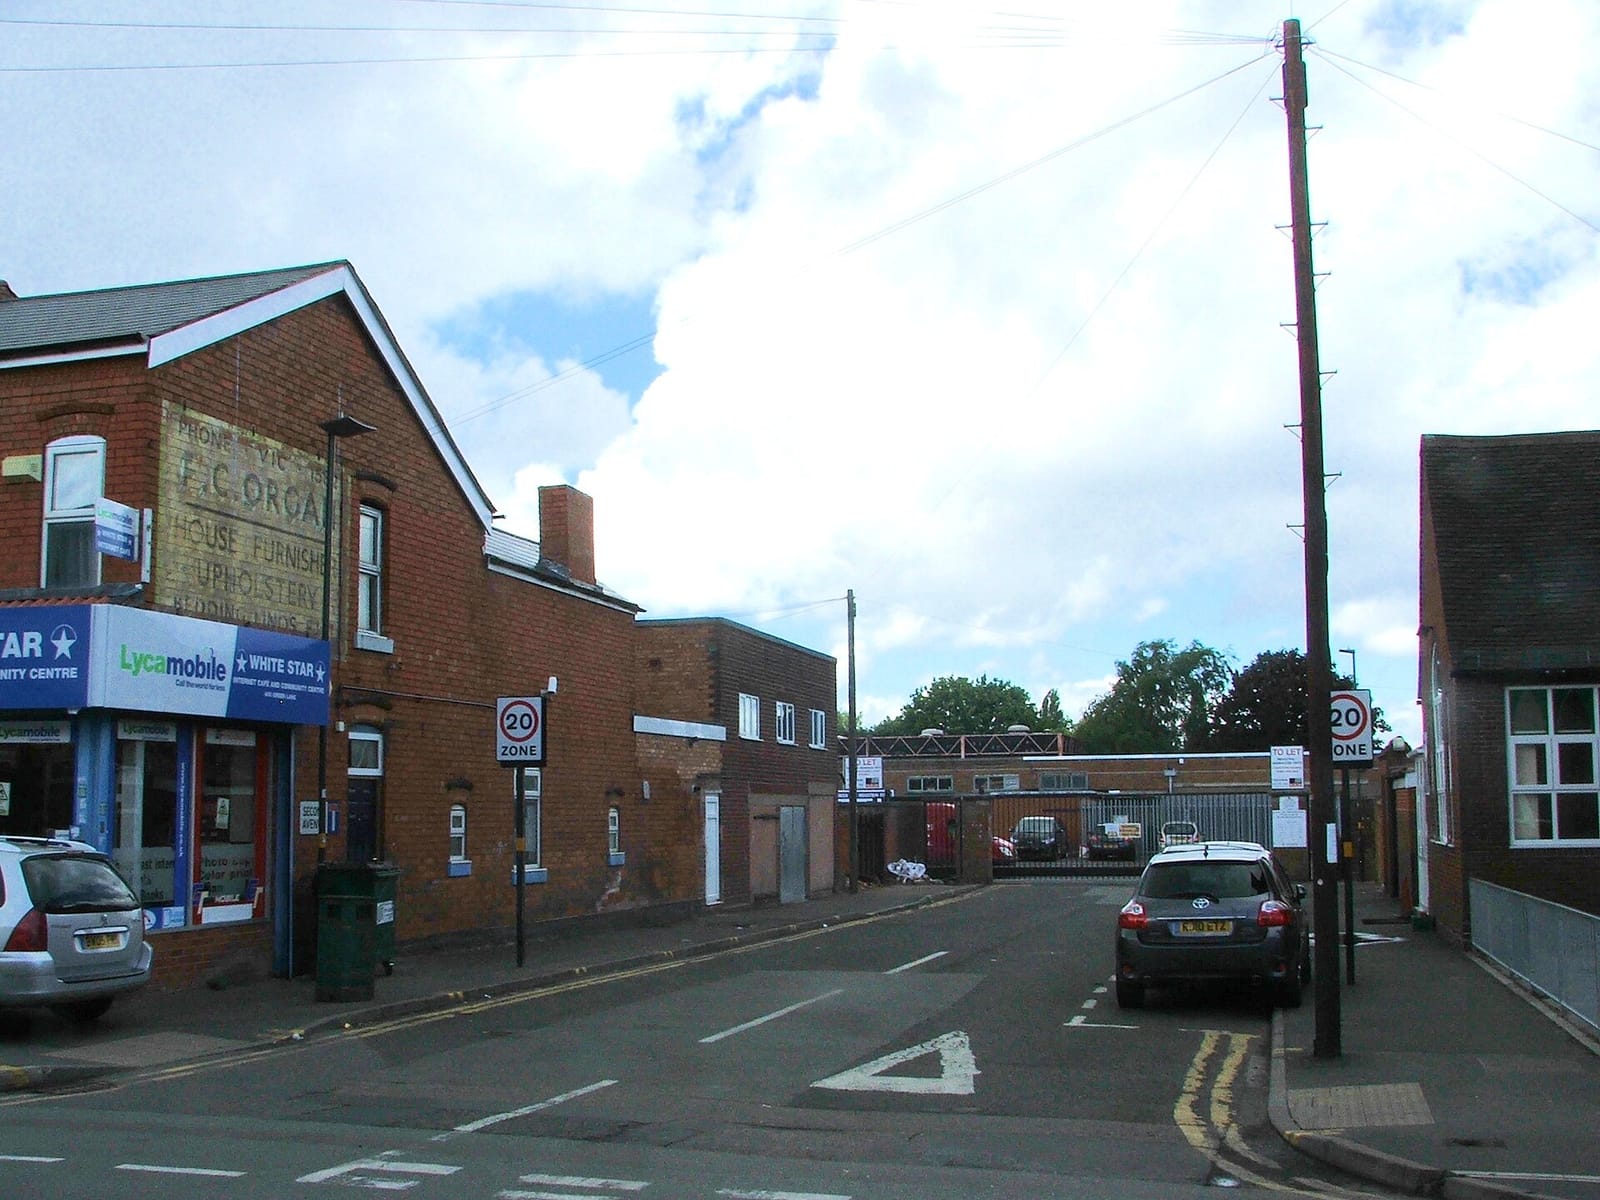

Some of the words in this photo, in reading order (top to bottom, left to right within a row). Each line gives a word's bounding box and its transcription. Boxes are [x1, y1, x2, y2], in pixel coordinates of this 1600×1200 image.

[120, 643, 226, 681] Lycamobile
[249, 654, 285, 673] WHITE
[287, 660, 314, 677] STAR
[29, 667, 78, 679] CENTRE
[506, 713, 533, 730] 20
[1331, 708, 1361, 727] 20
[501, 746, 537, 756] ZONE
[1272, 748, 1284, 756] TO
[1286, 748, 1301, 756] LET
[1333, 744, 1367, 756] ONE
[303, 806, 319, 817] SECO
[303, 819, 318, 830] AVEN
